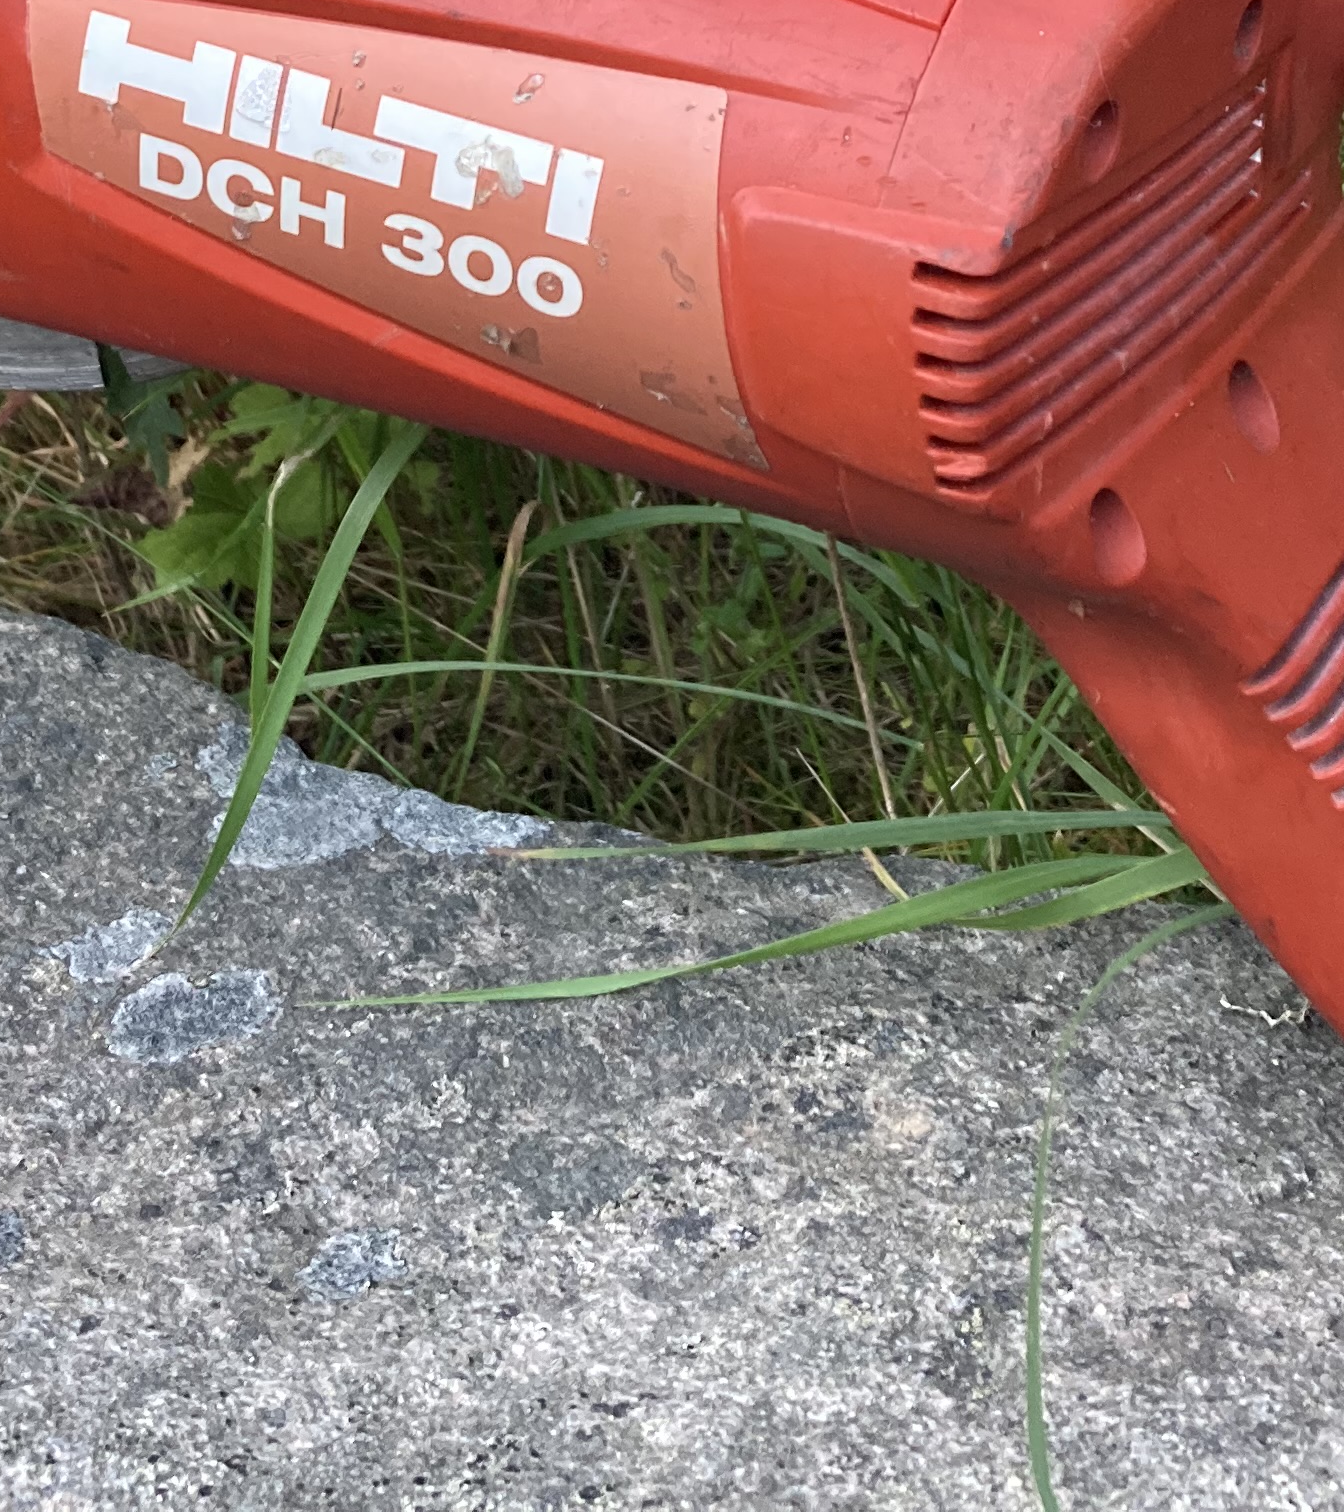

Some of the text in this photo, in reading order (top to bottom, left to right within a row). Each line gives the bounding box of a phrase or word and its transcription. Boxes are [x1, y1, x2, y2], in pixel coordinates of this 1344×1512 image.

[78, 10, 605, 245] HILTI
[138, 133, 584, 317] DCH 300
